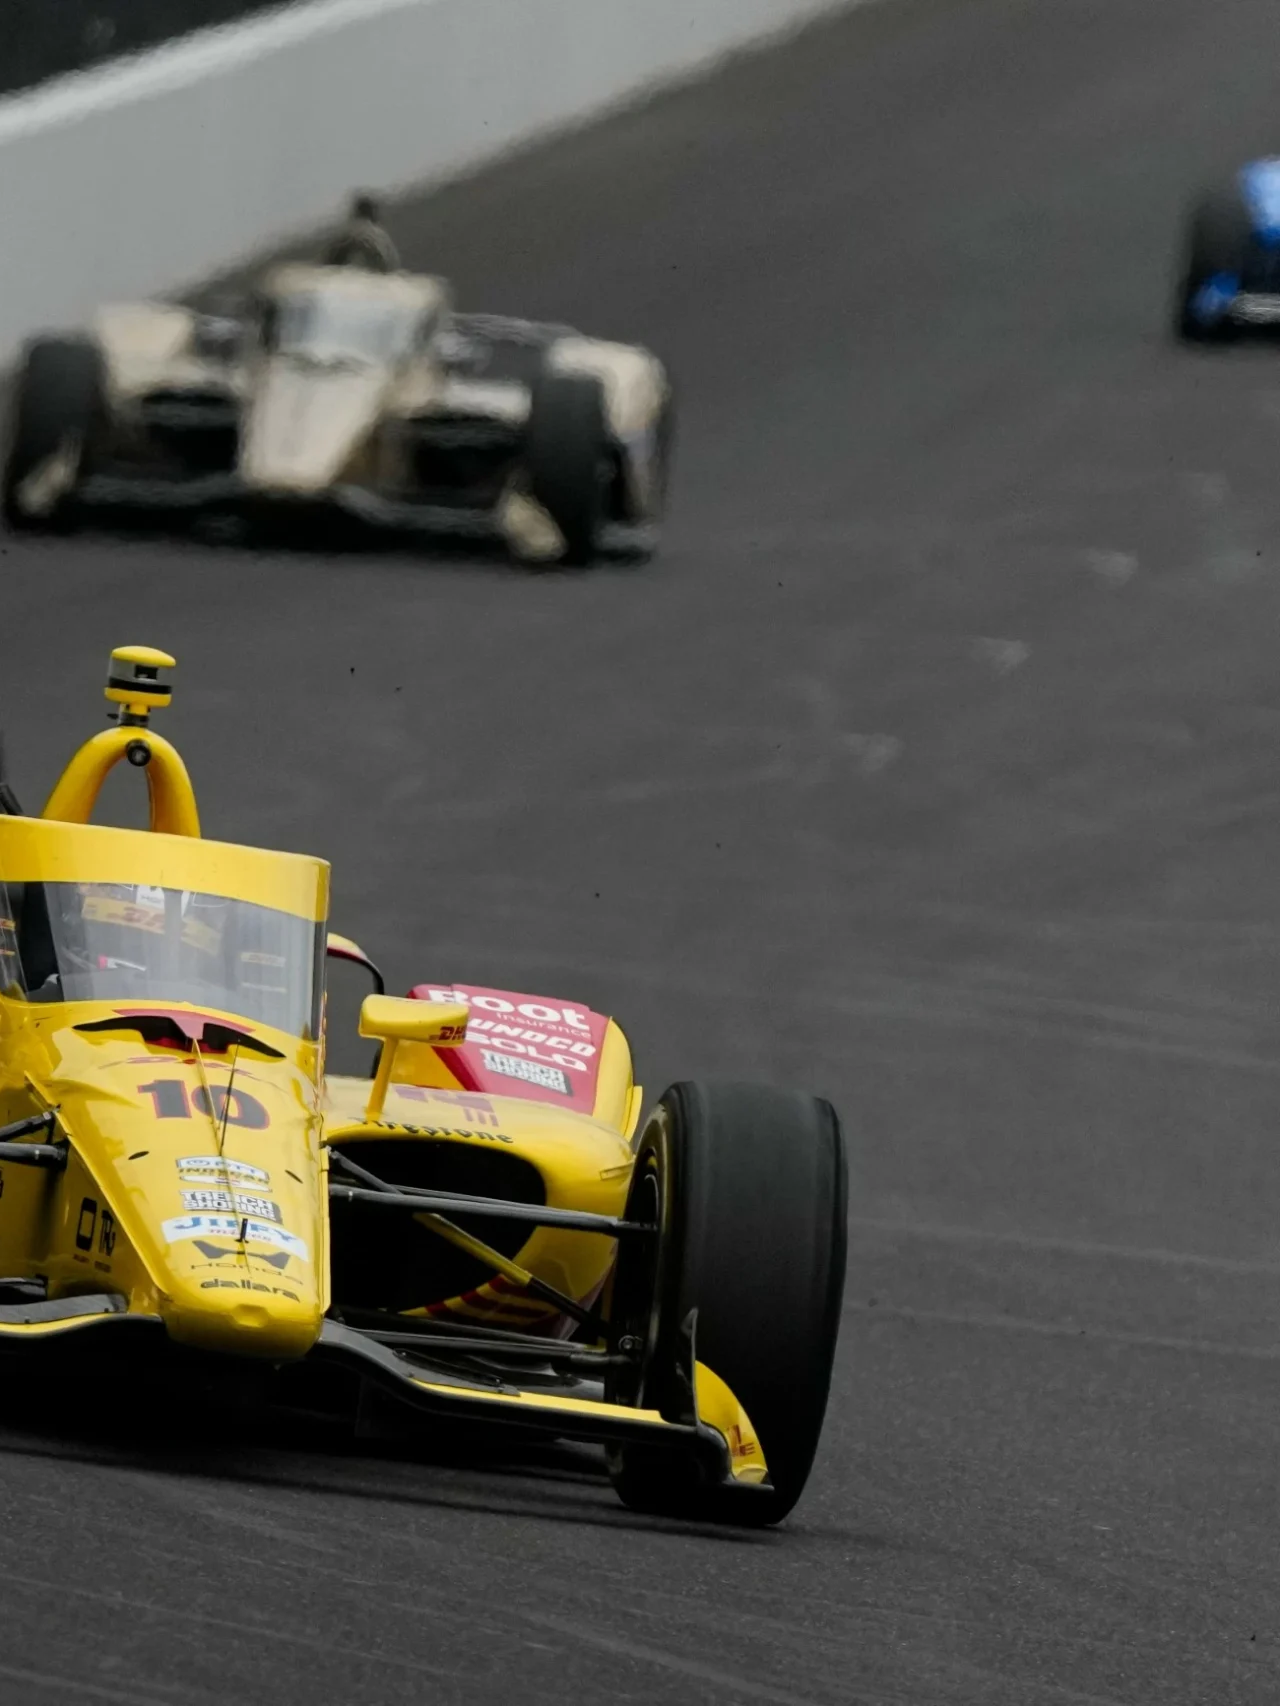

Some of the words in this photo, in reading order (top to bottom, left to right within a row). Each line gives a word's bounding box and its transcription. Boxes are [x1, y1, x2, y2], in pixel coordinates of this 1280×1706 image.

[465, 1031, 587, 1072] SOLO
[467, 1018, 596, 1057] UNOCO
[137, 1079, 270, 1130] 10
[200, 1278, 301, 1303] dallara
